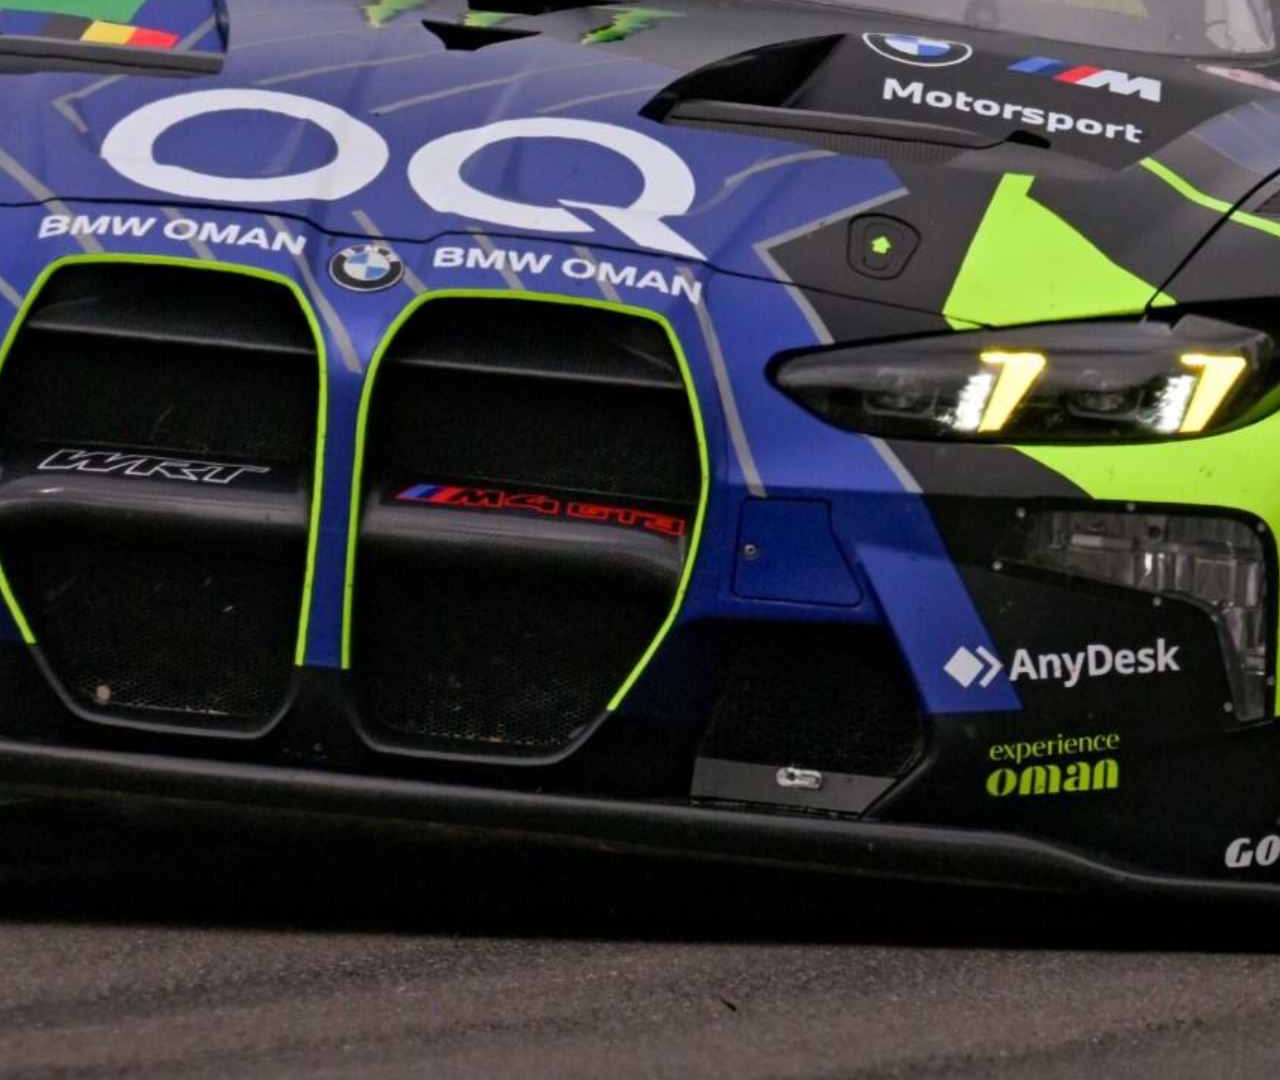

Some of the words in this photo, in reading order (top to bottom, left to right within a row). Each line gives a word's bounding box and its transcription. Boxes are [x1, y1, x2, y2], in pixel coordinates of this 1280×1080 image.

[881, 77, 1144, 144] Motorsport
[101, 88, 708, 260] OQ
[39, 214, 155, 241] BMW
[163, 218, 307, 256] OMAN
[432, 245, 550, 276] BMW
[561, 256, 704, 305] OMAN
[37, 448, 272, 485] WRT
[1009, 638, 1180, 687] AnyDesk
[988, 733, 1120, 764] experience
[985, 758, 1119, 797] oman
